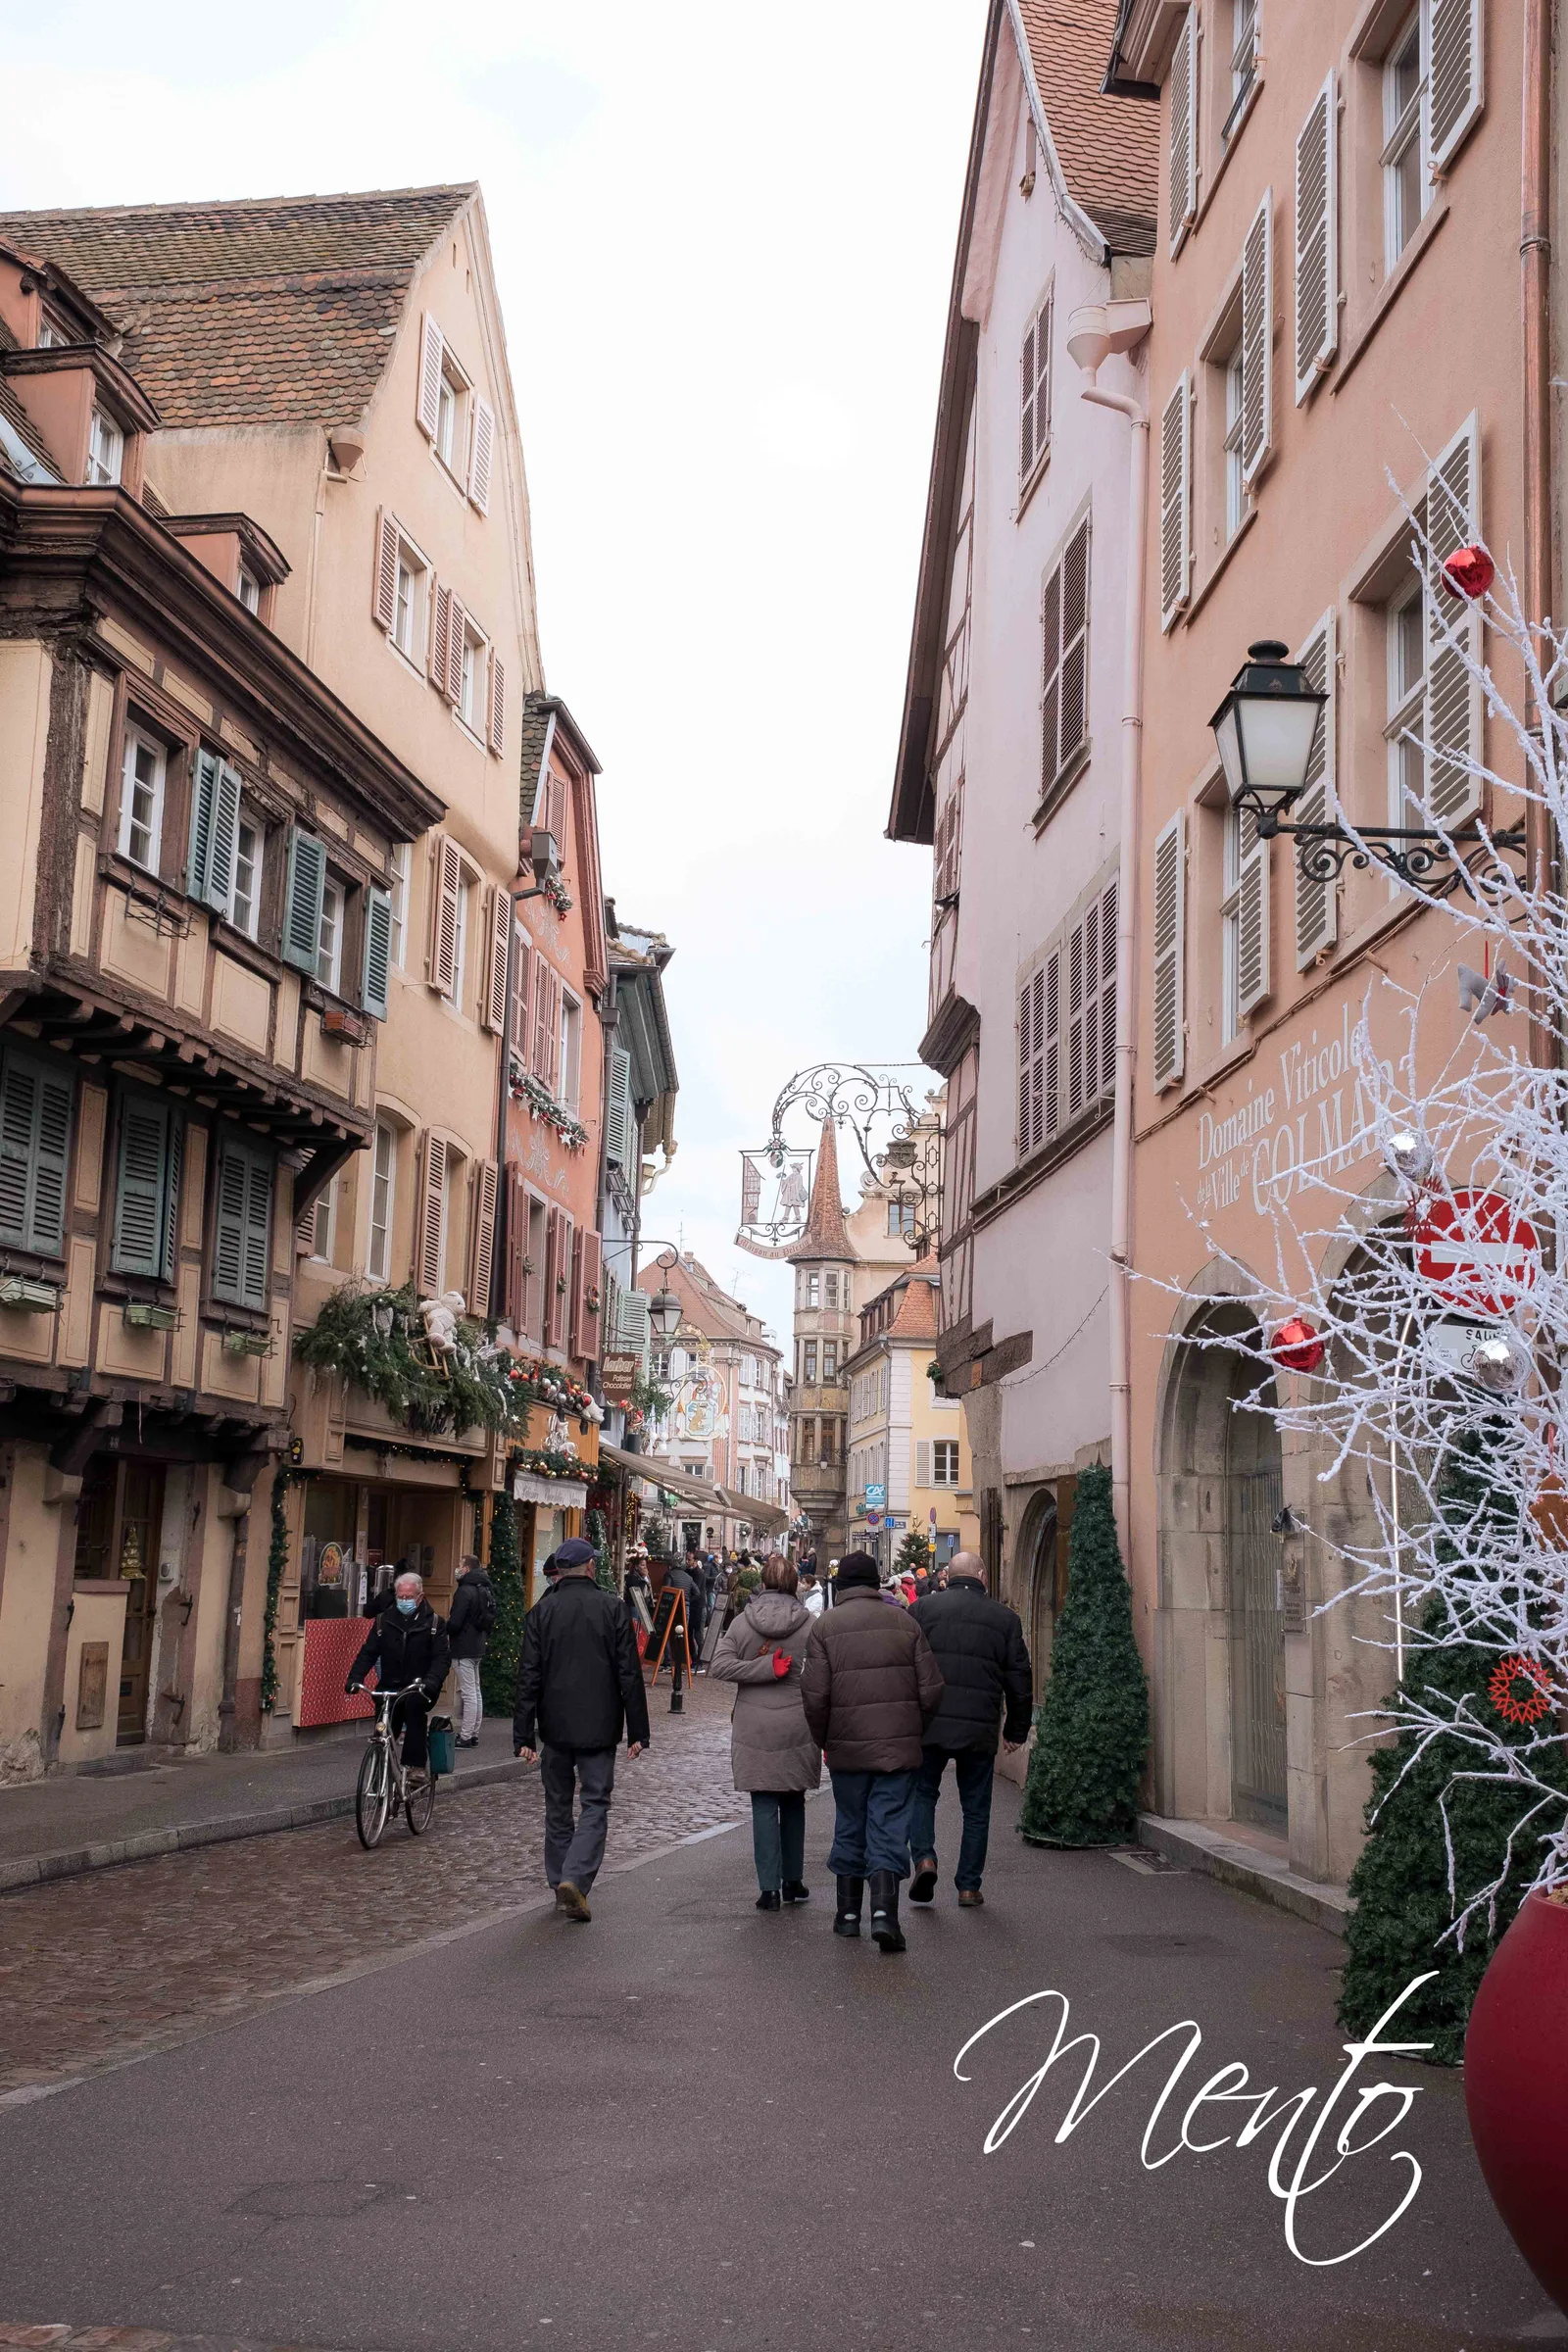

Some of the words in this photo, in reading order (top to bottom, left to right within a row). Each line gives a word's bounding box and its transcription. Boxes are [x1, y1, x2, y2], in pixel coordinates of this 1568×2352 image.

[1199, 1078, 1275, 1171] Domaine
[1280, 1001, 1365, 1110] Viticole
[1211, 1157, 1241, 1211] Ville
[1241, 1152, 1250, 1177] de
[1251, 1059, 1397, 1216] COLMAR
[738, 1239, 767, 1256] Maison
[603, 1356, 635, 1373] Lorber
[602, 1381, 633, 1390] Chocolatier
